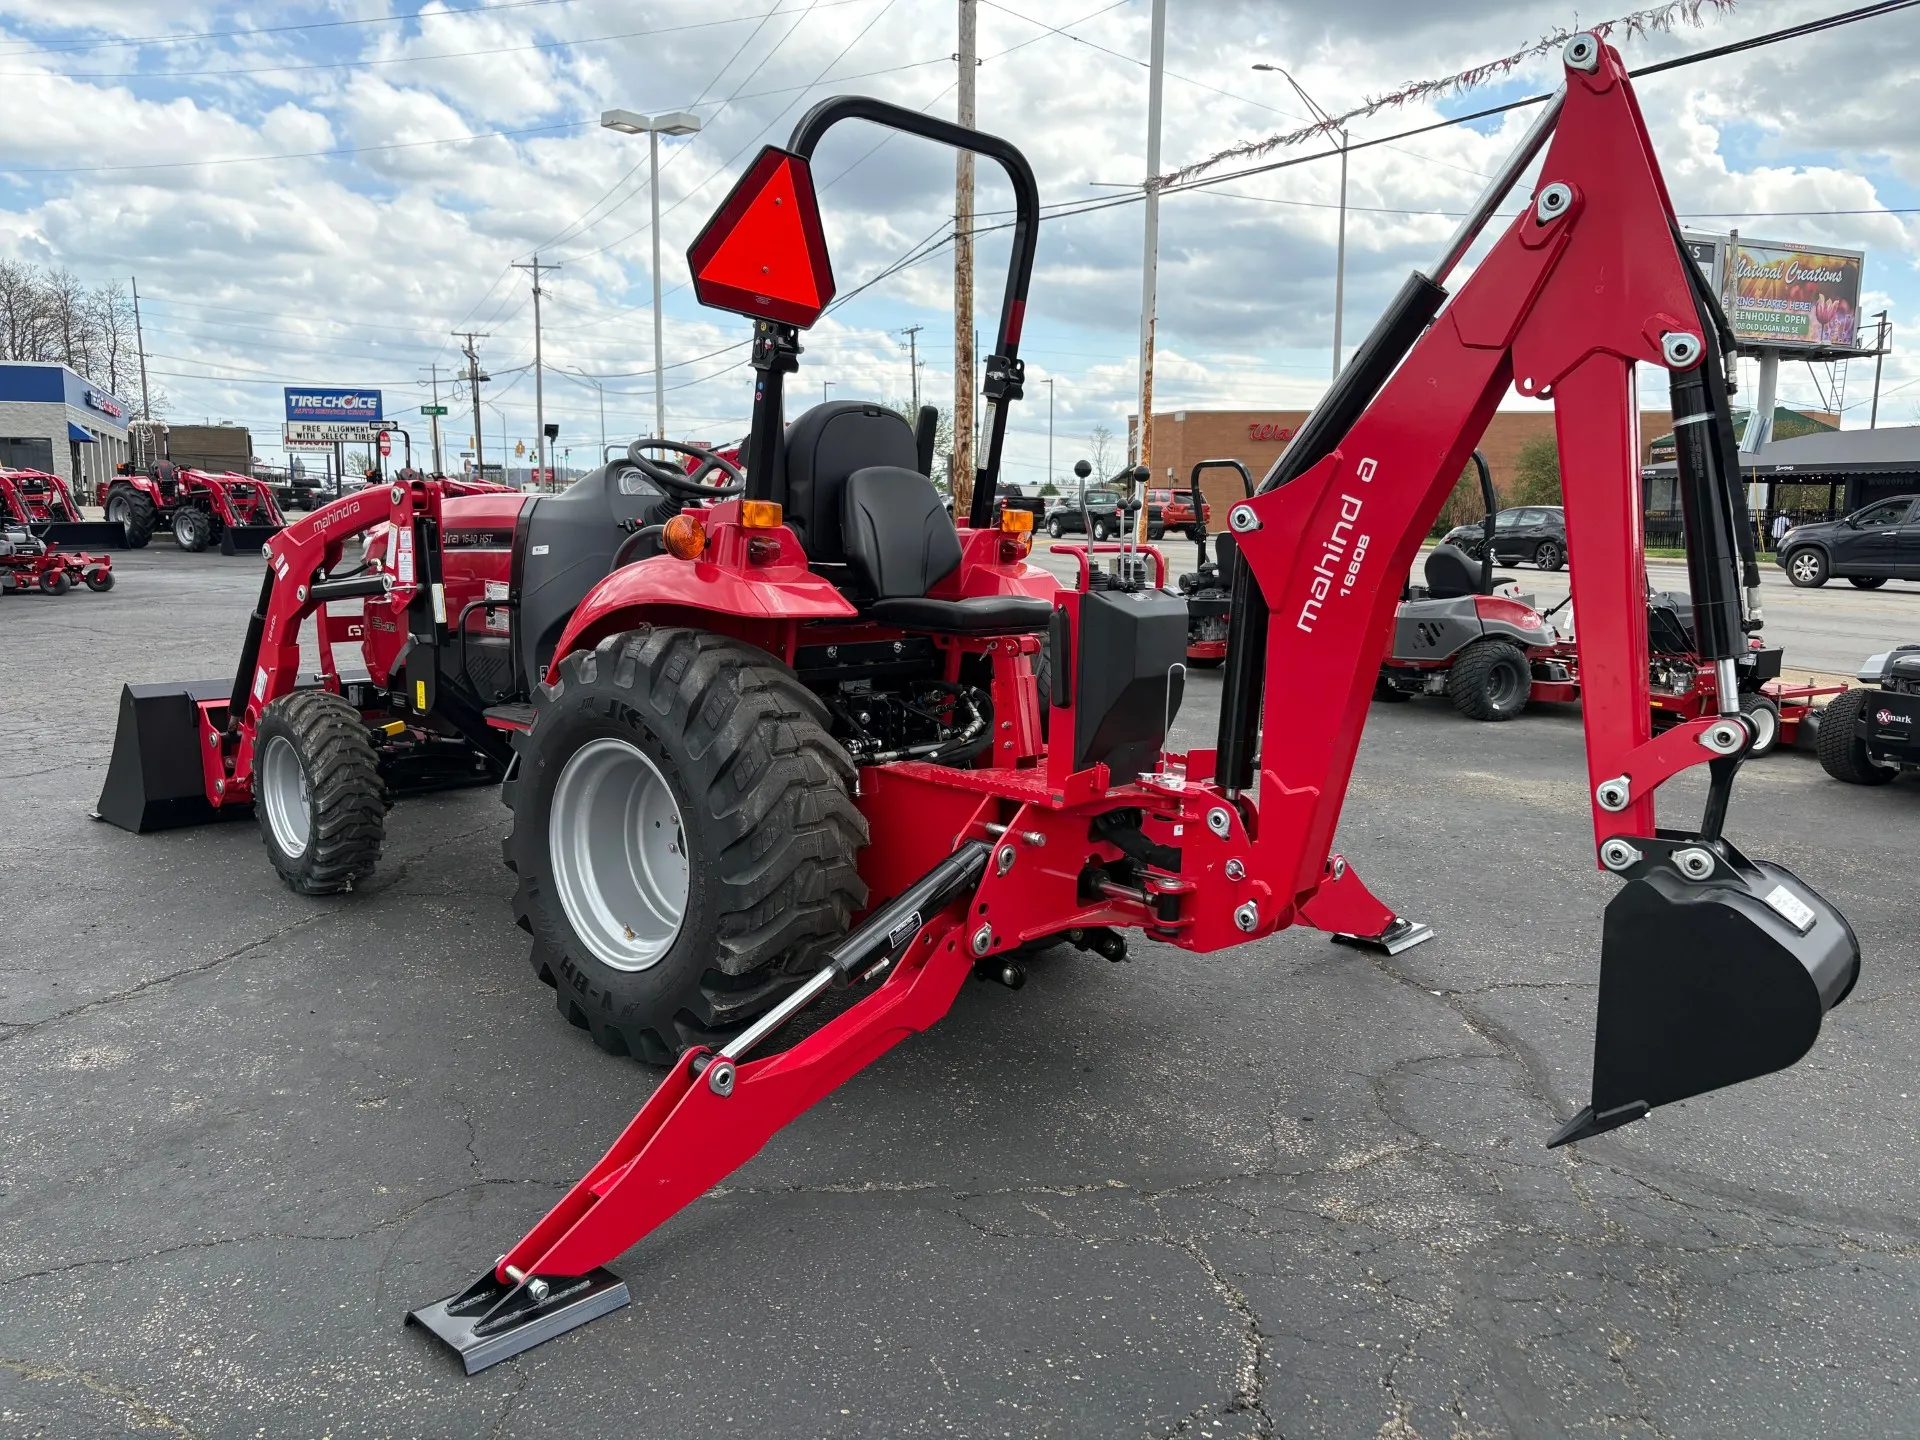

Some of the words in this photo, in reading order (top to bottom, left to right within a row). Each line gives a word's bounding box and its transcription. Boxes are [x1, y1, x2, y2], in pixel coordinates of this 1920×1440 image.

[1785, 260, 1843, 284] Creations
[1723, 295, 1755, 307] SRING
[1757, 298, 1788, 310] STARTS
[1789, 301, 1812, 312] HERE!
[1723, 309, 1780, 323] GEENHOUSE
[1784, 314, 1807, 325] OPEN
[1760, 324, 1780, 332] LOGAN
[296, 432, 316, 440] WITH
[354, 433, 376, 441] TIRES
[328, 425, 369, 433] ALIGNMENT
[313, 501, 360, 533] mahindra
[462, 534, 478, 544] 1640
[480, 534, 494, 544] HST
[1340, 534, 1370, 597] 1660B
